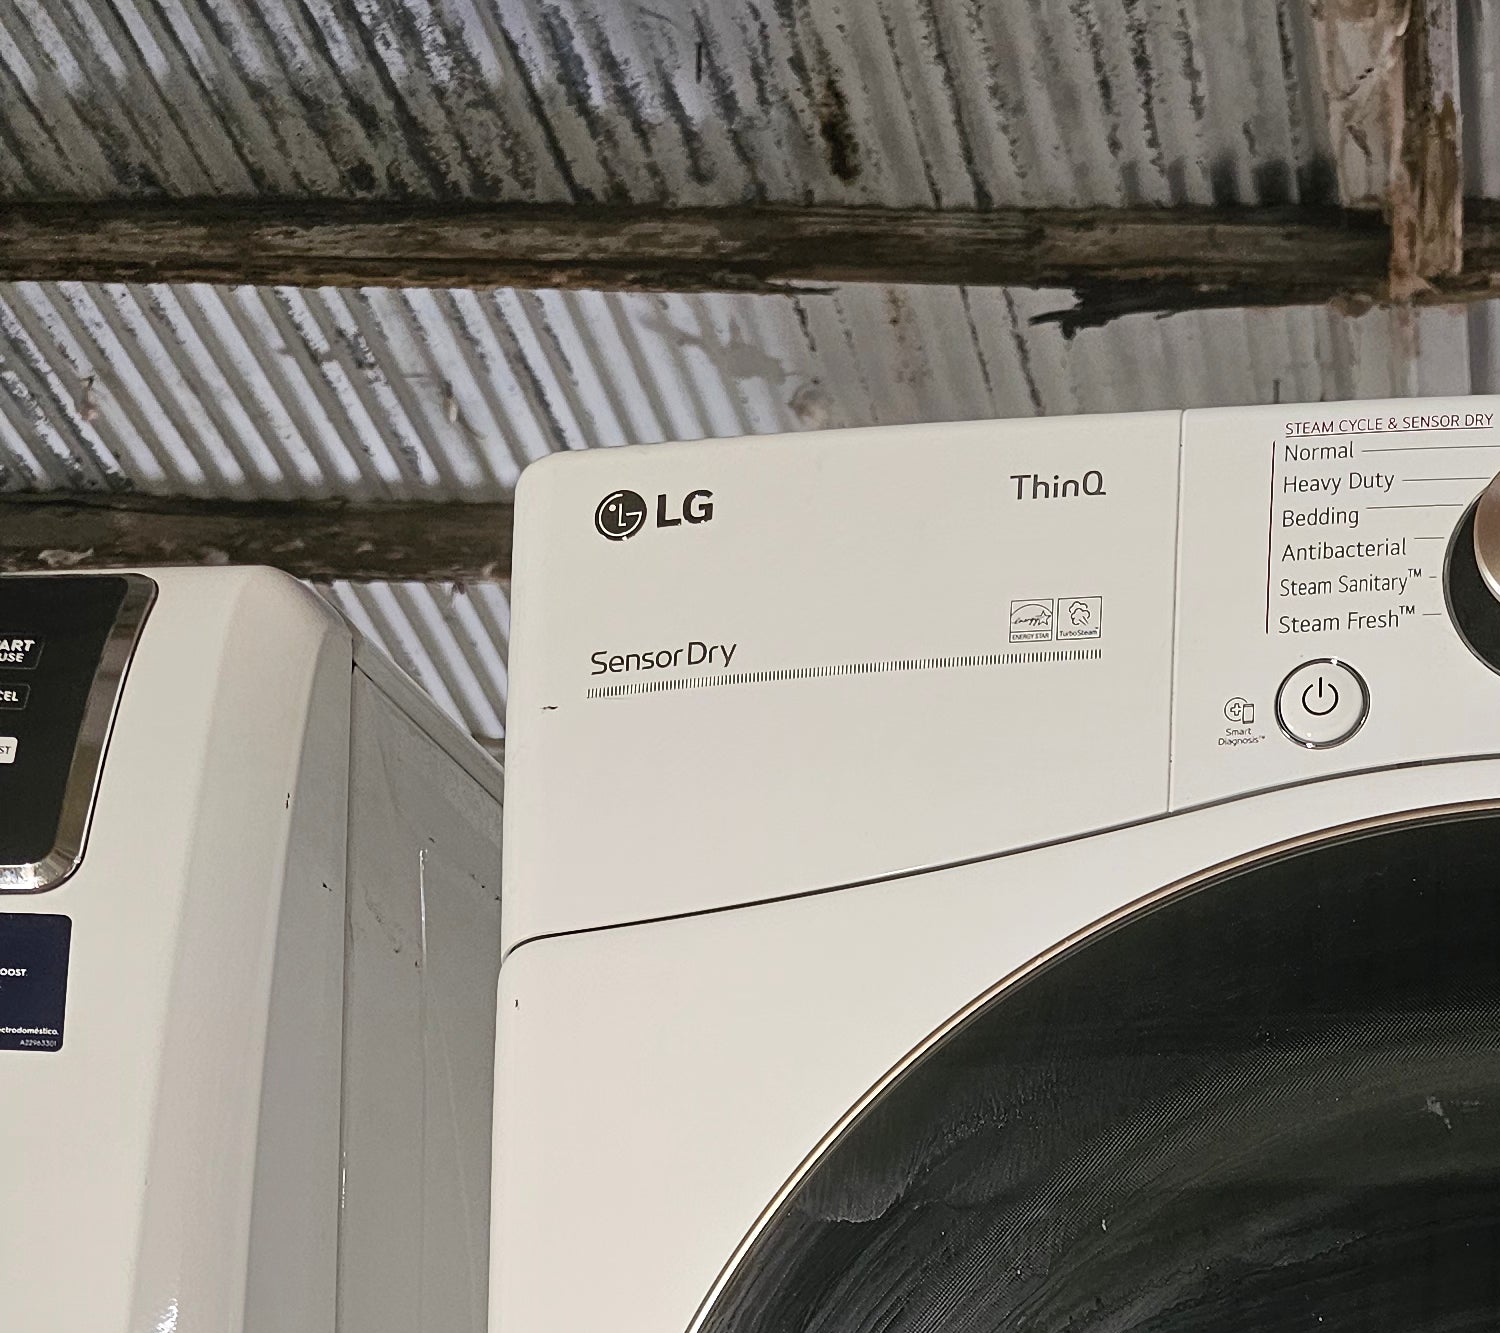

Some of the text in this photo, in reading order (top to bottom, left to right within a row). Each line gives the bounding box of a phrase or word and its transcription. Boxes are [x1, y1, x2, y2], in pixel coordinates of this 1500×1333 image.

[1285, 413, 1494, 435] STEAM CYCLE & SENSOR DRY
[1285, 441, 1354, 462] Normal
[1010, 470, 1106, 502] ThinQ
[1284, 472, 1395, 496] Heavy Duty
[656, 489, 714, 528] LG
[1282, 508, 1359, 529] Bedding
[1281, 537, 1407, 562] Antibacterial
[1280, 578, 1332, 597] Steam
[1278, 615, 1340, 634] Steam
[0, 639, 36, 652] ART
[1225, 728, 1252, 737] Smart
